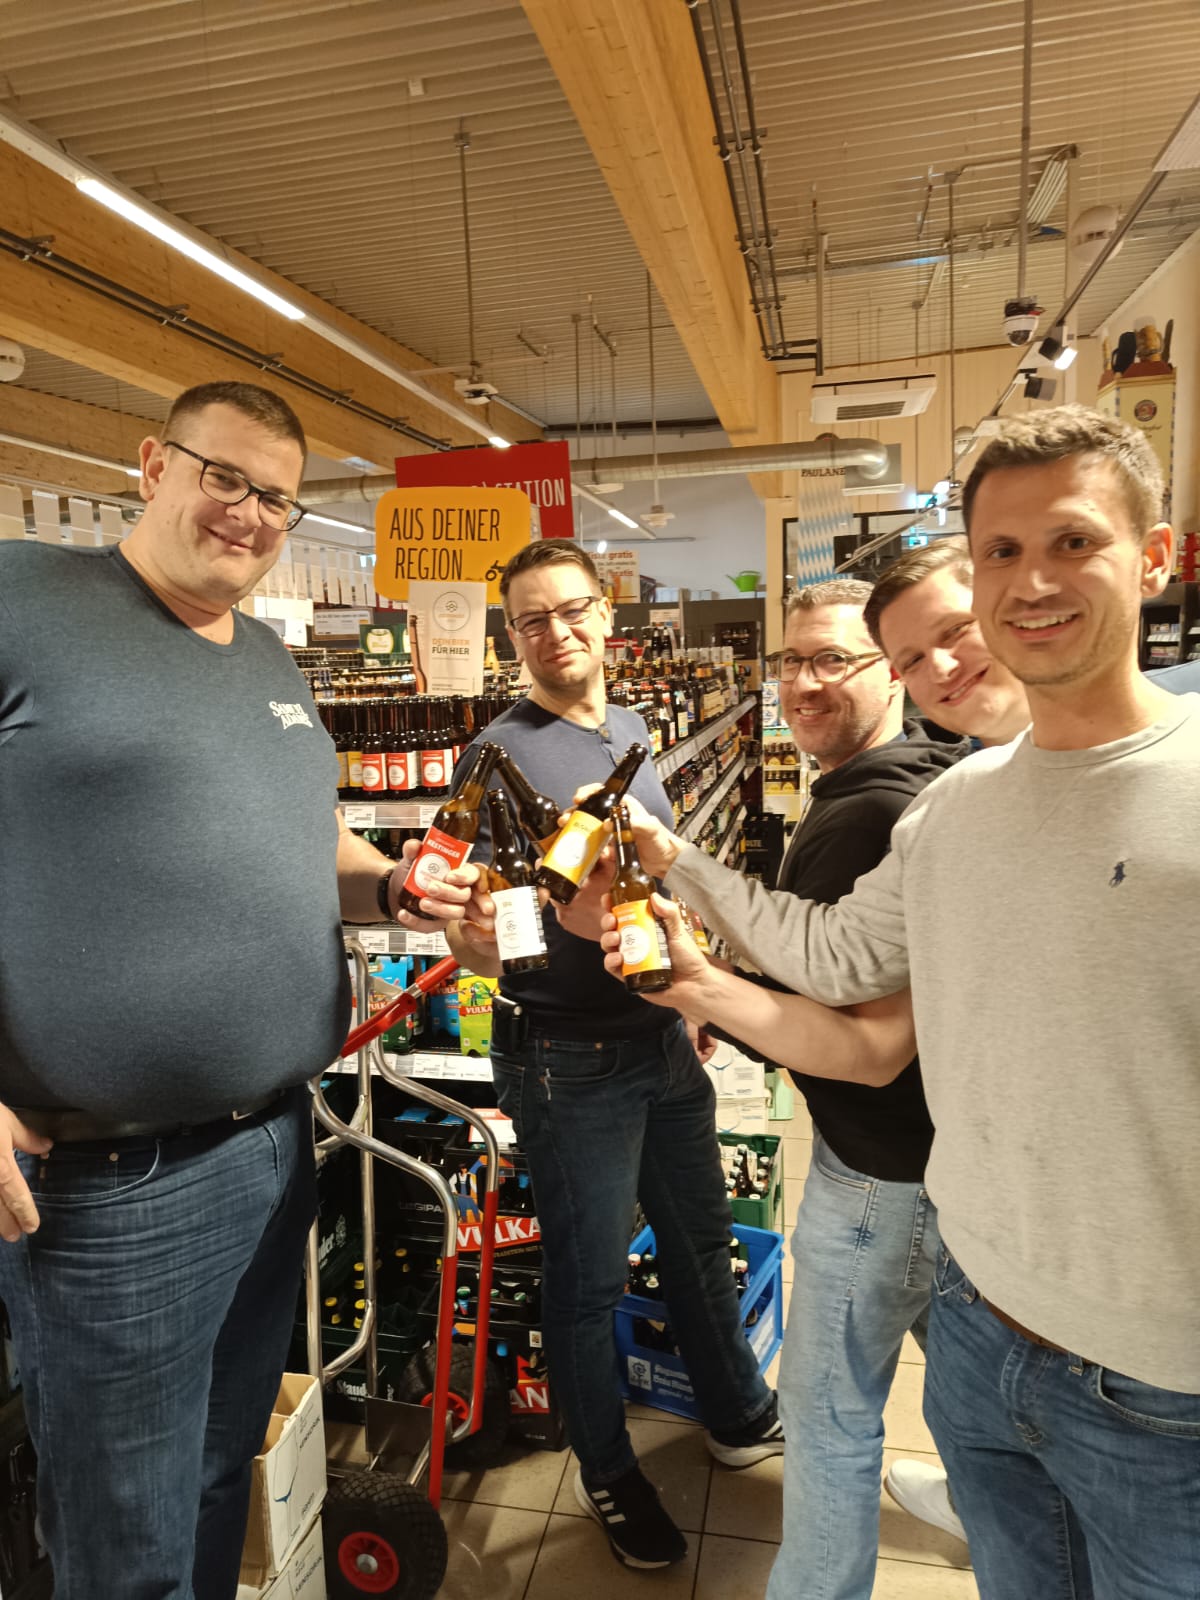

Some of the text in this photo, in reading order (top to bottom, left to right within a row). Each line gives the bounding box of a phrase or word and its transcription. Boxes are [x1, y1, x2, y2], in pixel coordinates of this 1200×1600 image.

[389, 507, 500, 541] AUS DEINER
[394, 547, 463, 580] REGION
[432, 644, 470, 655] FÜR HIER
